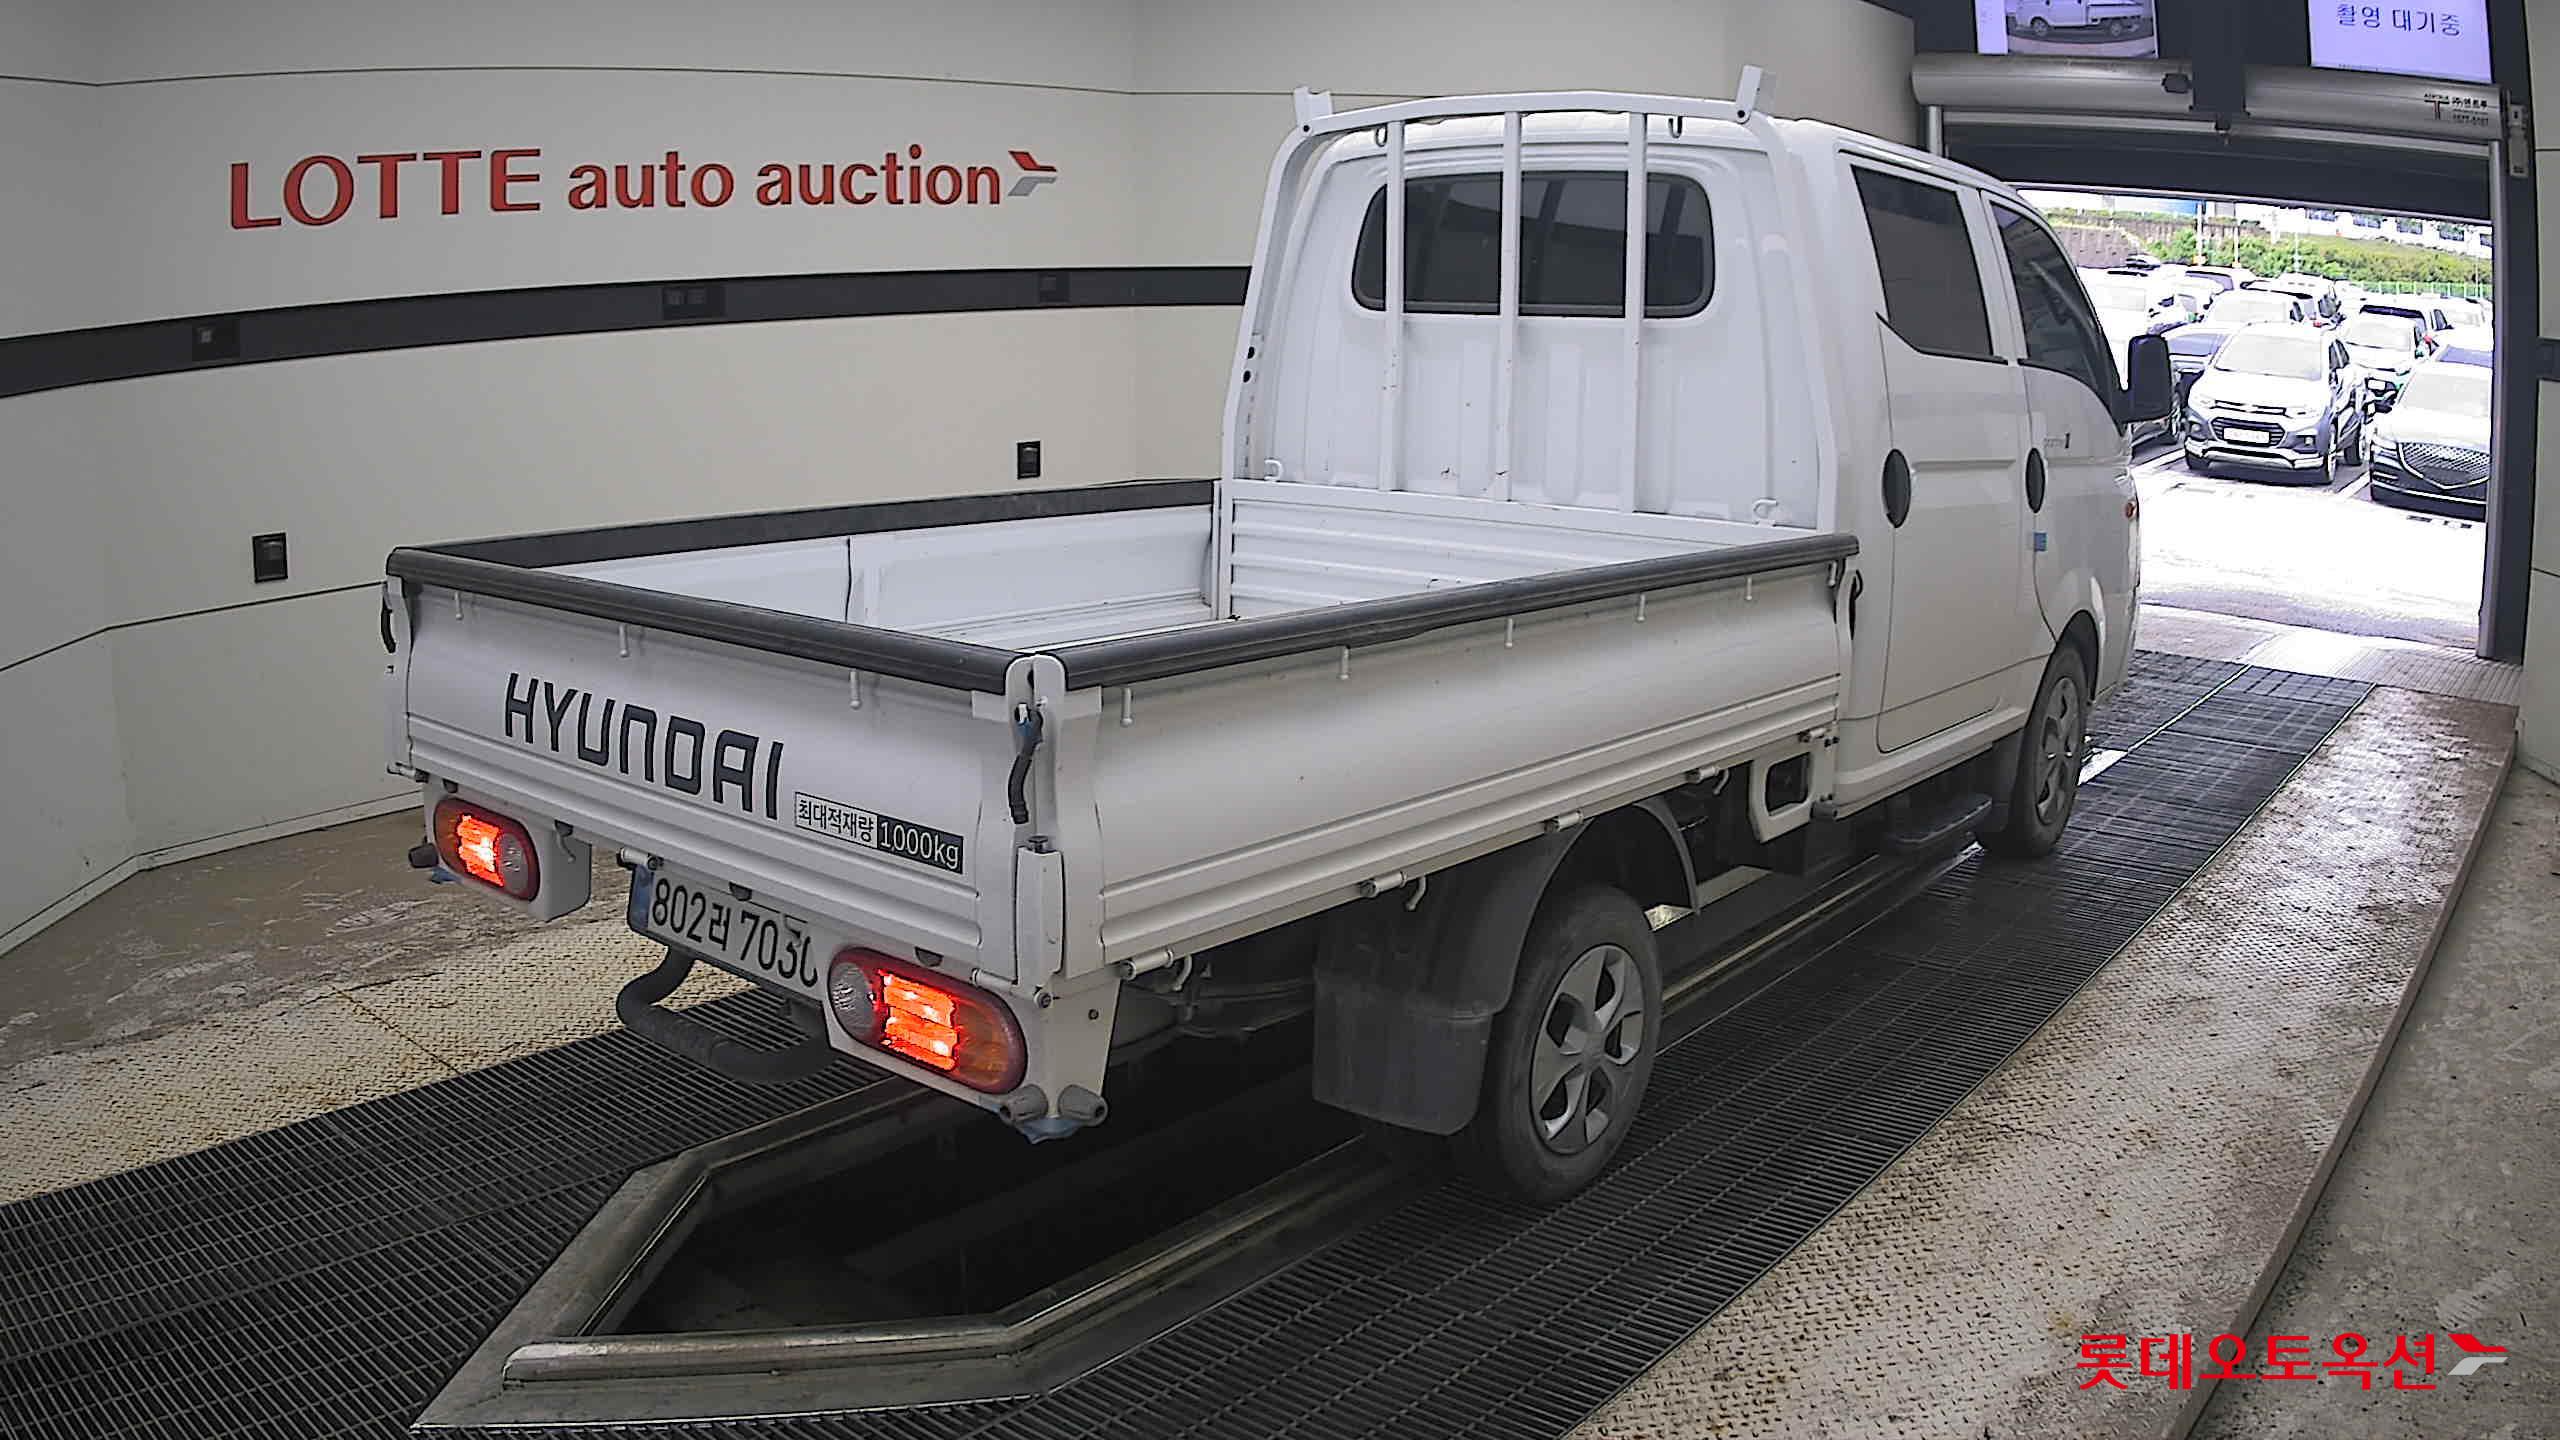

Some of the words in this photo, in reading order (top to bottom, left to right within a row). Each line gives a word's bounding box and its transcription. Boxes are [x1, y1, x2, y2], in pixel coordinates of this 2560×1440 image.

[2337, 4, 2380, 29] 촬영
[2392, 10, 2461, 37] 대기중
[230, 149, 541, 229] LOTTE
[568, 150, 735, 209] auto
[756, 144, 1001, 206] auction
[505, 673, 784, 820] HYUNDAI
[798, 800, 874, 843] 최대적재량
